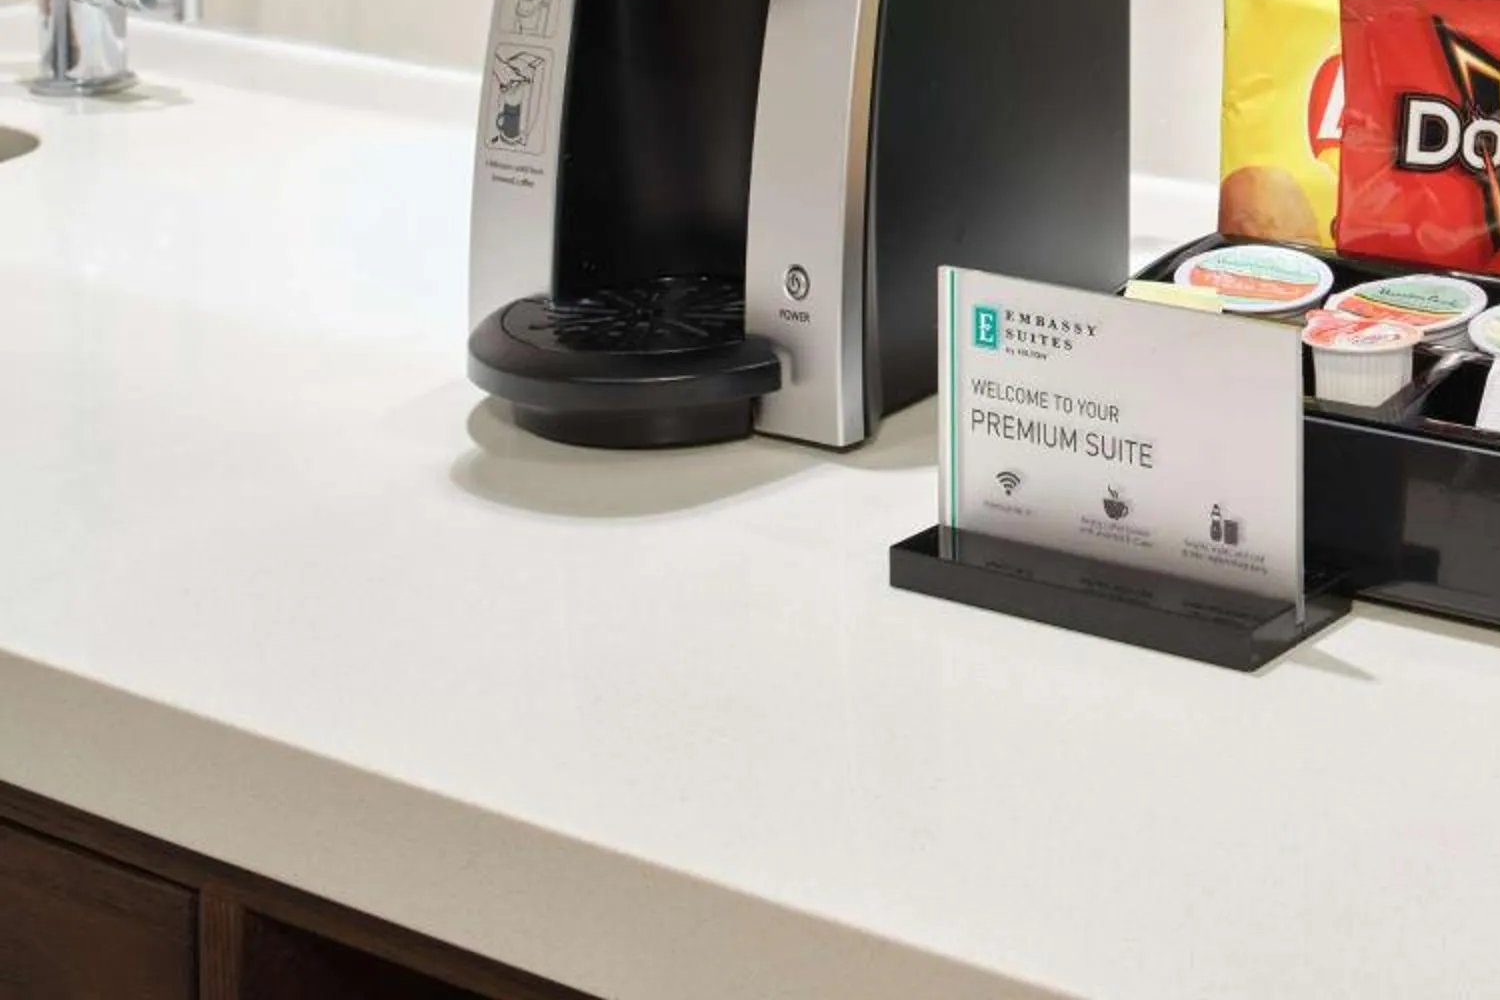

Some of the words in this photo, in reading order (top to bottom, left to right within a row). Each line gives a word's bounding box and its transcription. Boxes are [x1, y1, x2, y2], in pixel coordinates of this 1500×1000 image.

[779, 309, 811, 323] POWER
[1004, 309, 1098, 337] EMBASSY
[1004, 328, 1074, 350] SUITES
[970, 377, 1050, 409] WELCOME
[1053, 393, 1074, 414] TO
[1077, 398, 1120, 424] YOUR
[971, 407, 1078, 453] PREMIUM
[1084, 432, 1153, 468] SUITE
